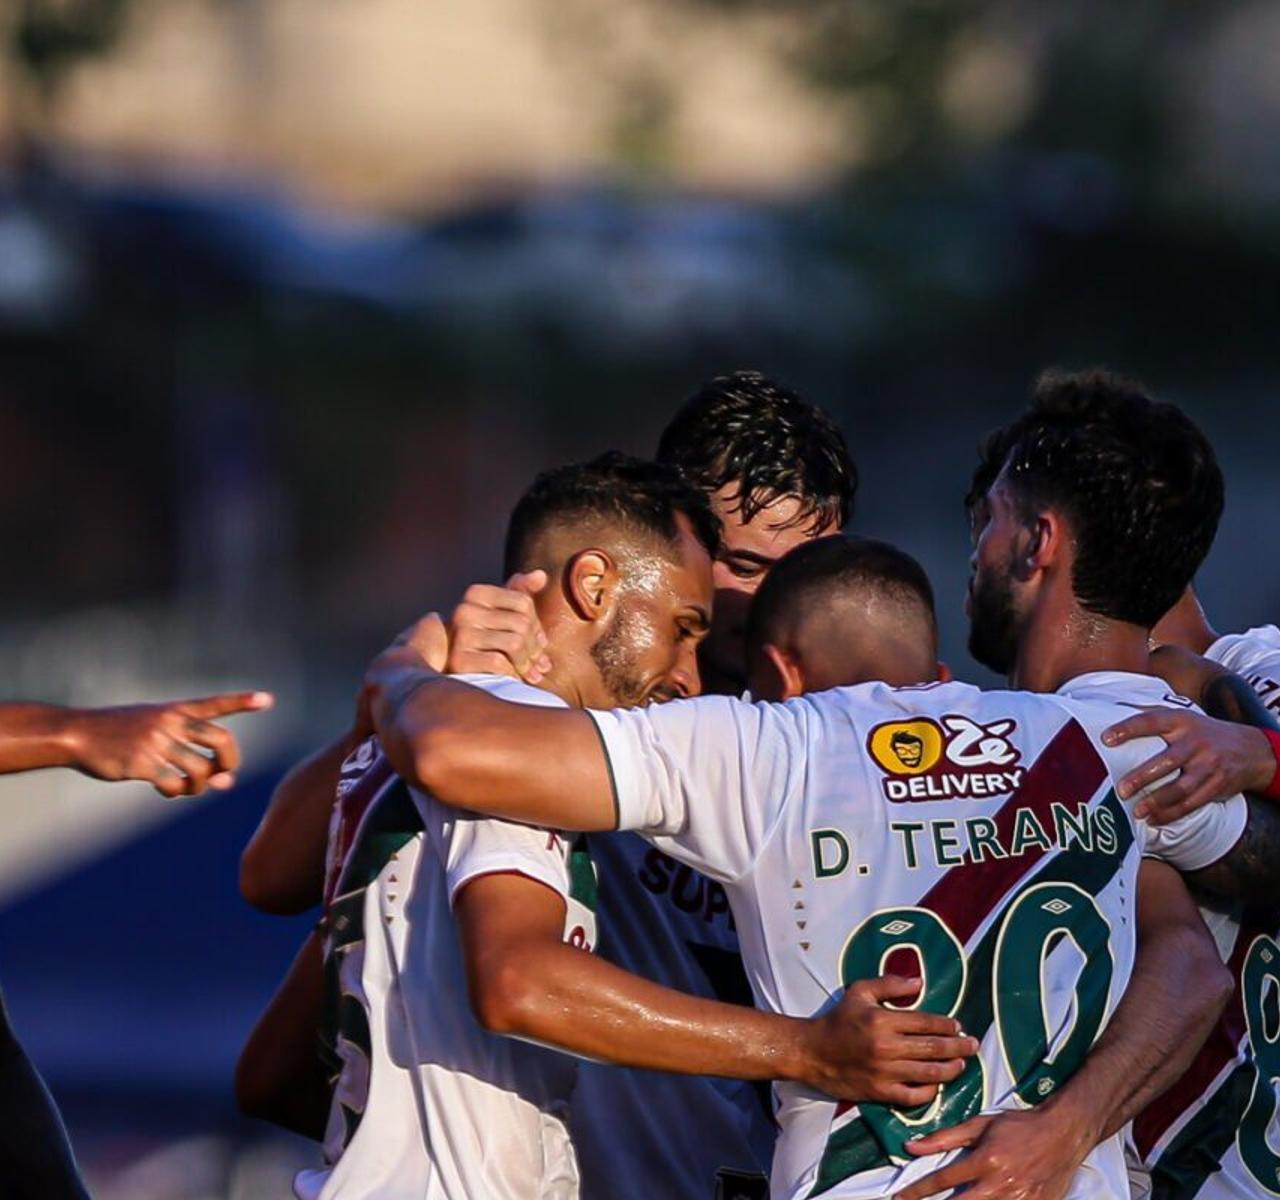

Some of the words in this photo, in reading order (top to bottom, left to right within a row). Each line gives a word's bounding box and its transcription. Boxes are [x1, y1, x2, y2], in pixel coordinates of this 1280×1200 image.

[946, 718, 1017, 767] Zé
[888, 771, 1022, 800] DELIVERY
[810, 827, 869, 879] D.
[892, 802, 1118, 869] TERANS
[639, 847, 736, 932] SUP
